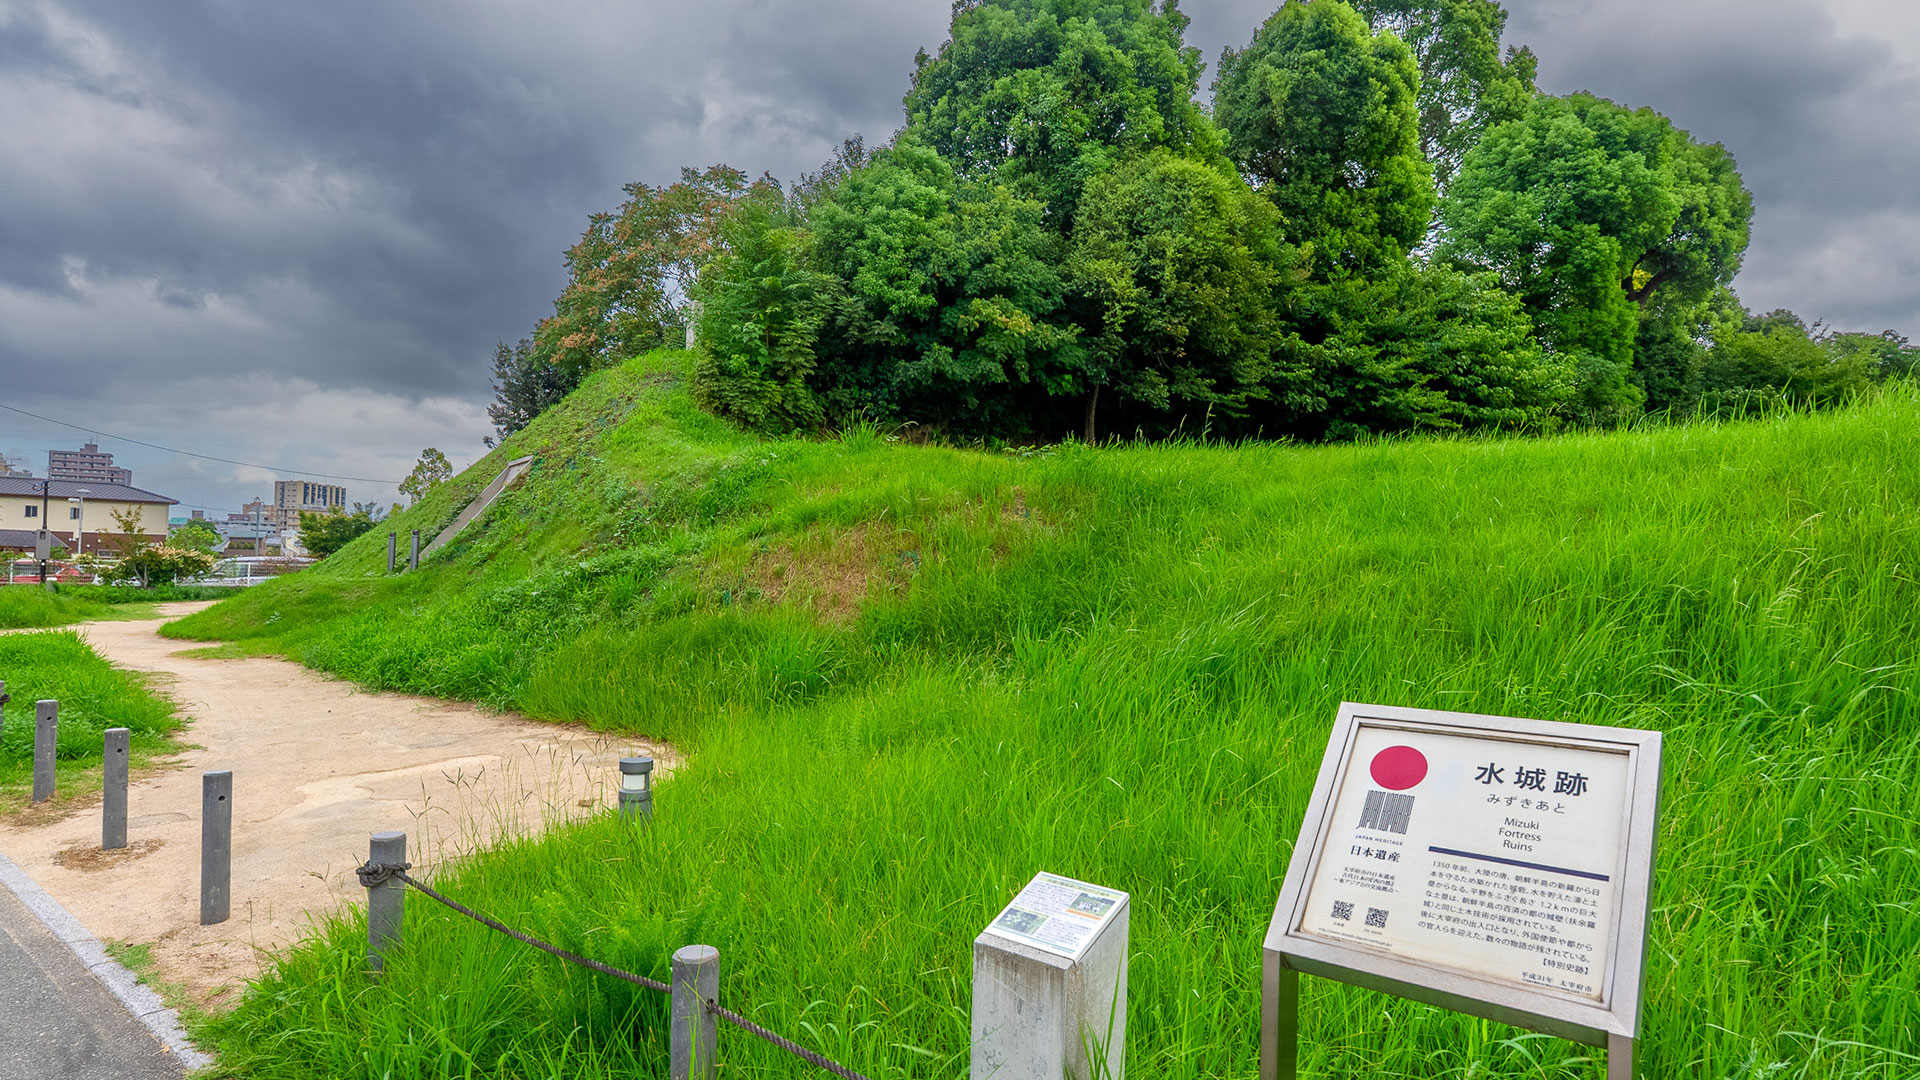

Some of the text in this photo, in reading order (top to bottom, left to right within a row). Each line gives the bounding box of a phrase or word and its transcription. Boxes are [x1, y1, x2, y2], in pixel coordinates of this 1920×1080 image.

[1474, 762, 1589, 797] 水城跡
[1487, 793, 1566, 814] みずきあと
[1504, 816, 1540, 830] Mizuki
[1374, 837, 1403, 846] HERITAGE
[1498, 827, 1541, 842] Fortress
[1503, 839, 1533, 852] Ruins
[1350, 845, 1401, 863] 日本遺産
